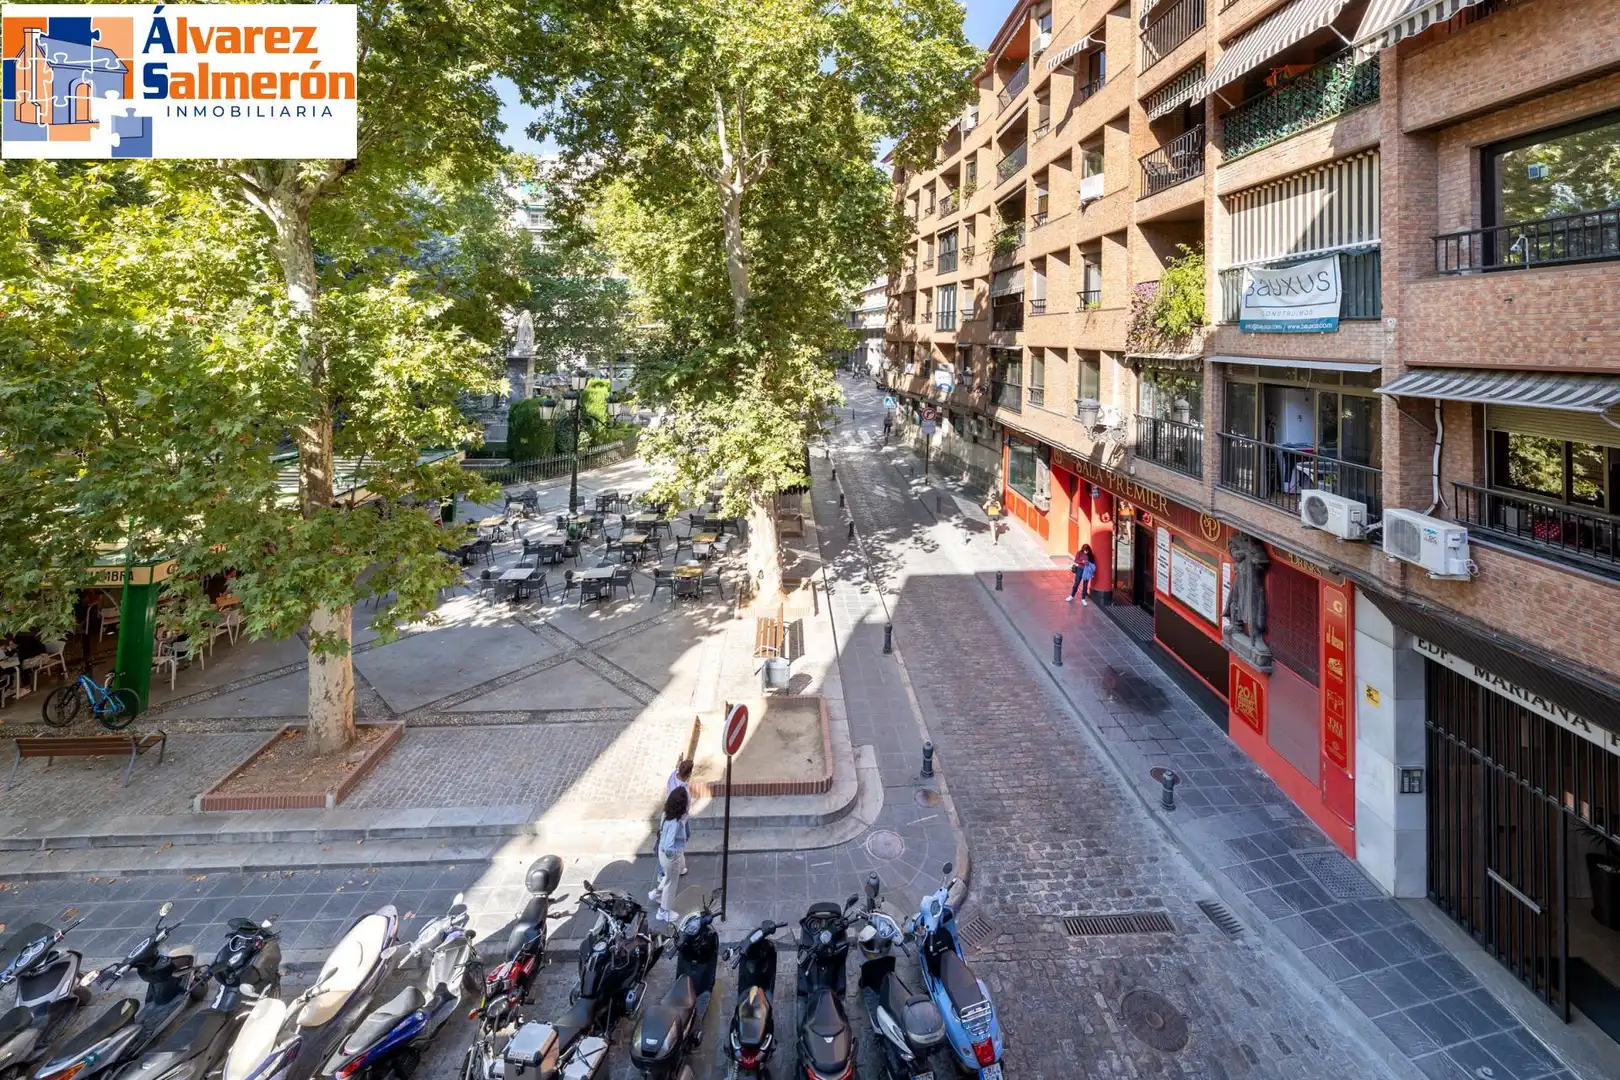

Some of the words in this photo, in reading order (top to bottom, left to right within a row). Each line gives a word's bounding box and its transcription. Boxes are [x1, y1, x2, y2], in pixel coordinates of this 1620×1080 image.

[1076, 458, 1103, 483] SALA
[1106, 471, 1170, 516] PREMIER
[1474, 665, 1592, 734] MARIANA
